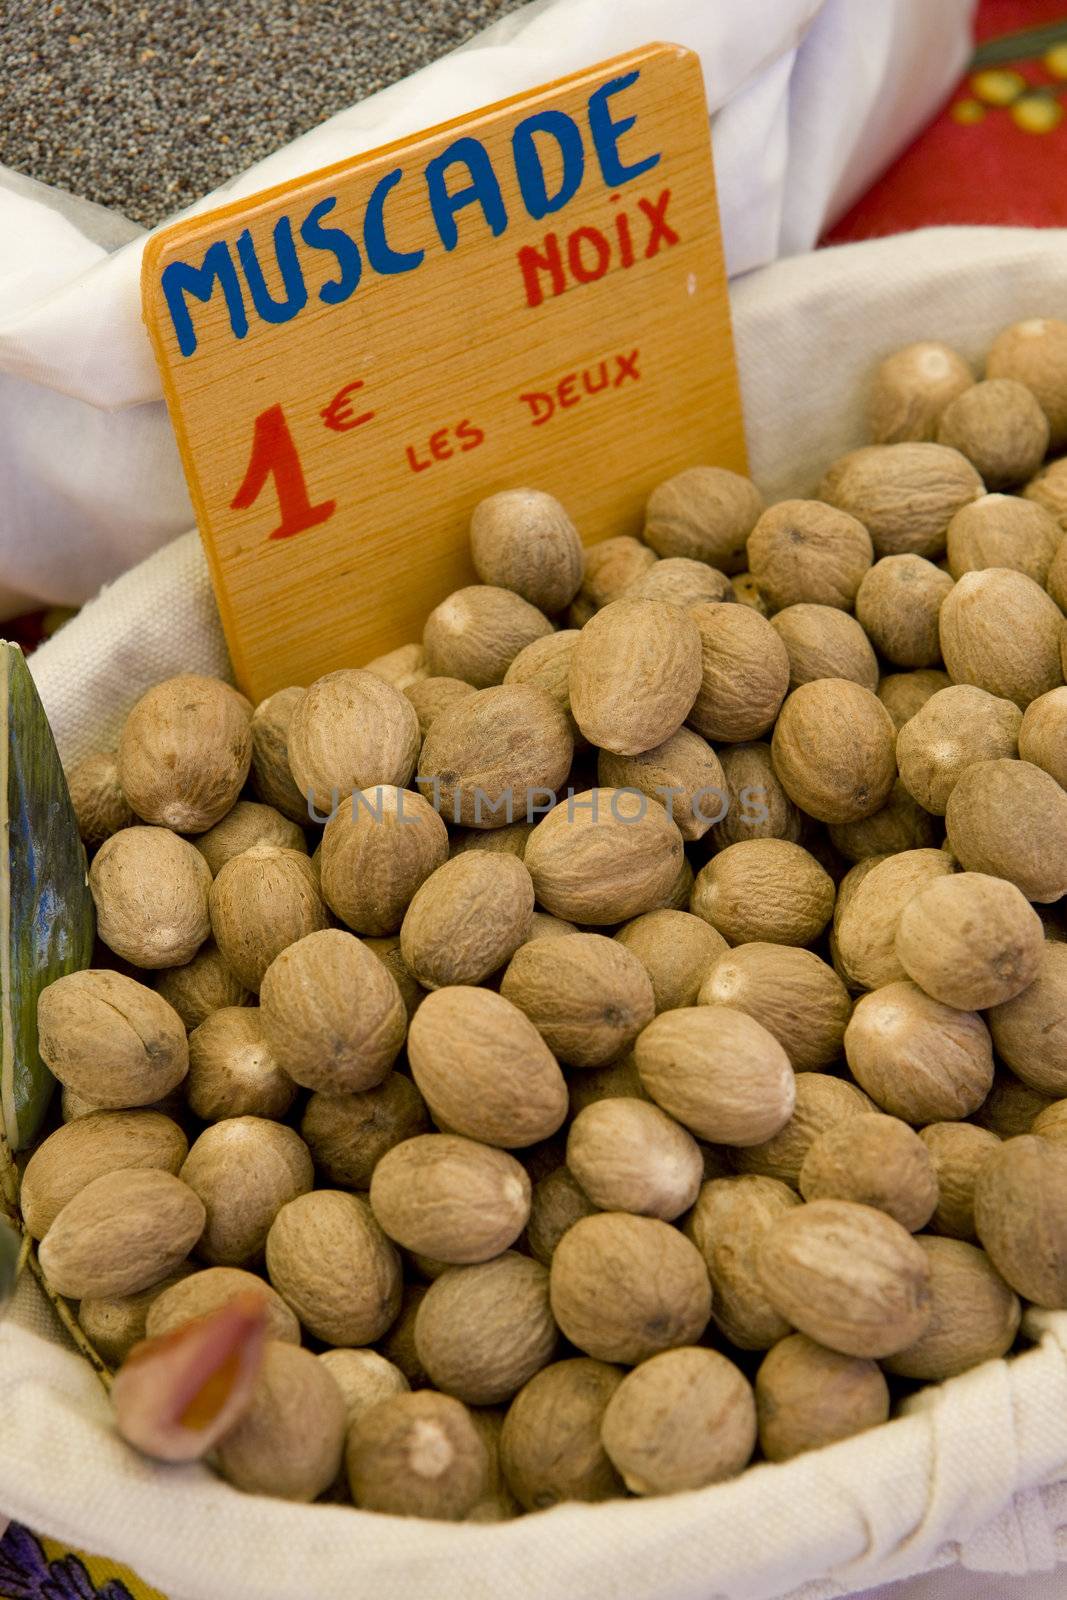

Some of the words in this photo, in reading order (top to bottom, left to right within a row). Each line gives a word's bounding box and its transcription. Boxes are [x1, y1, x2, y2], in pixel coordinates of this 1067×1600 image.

[161, 71, 661, 357] MUSCADE
[406, 419, 485, 472] LES
[519, 349, 640, 426] DEUX
